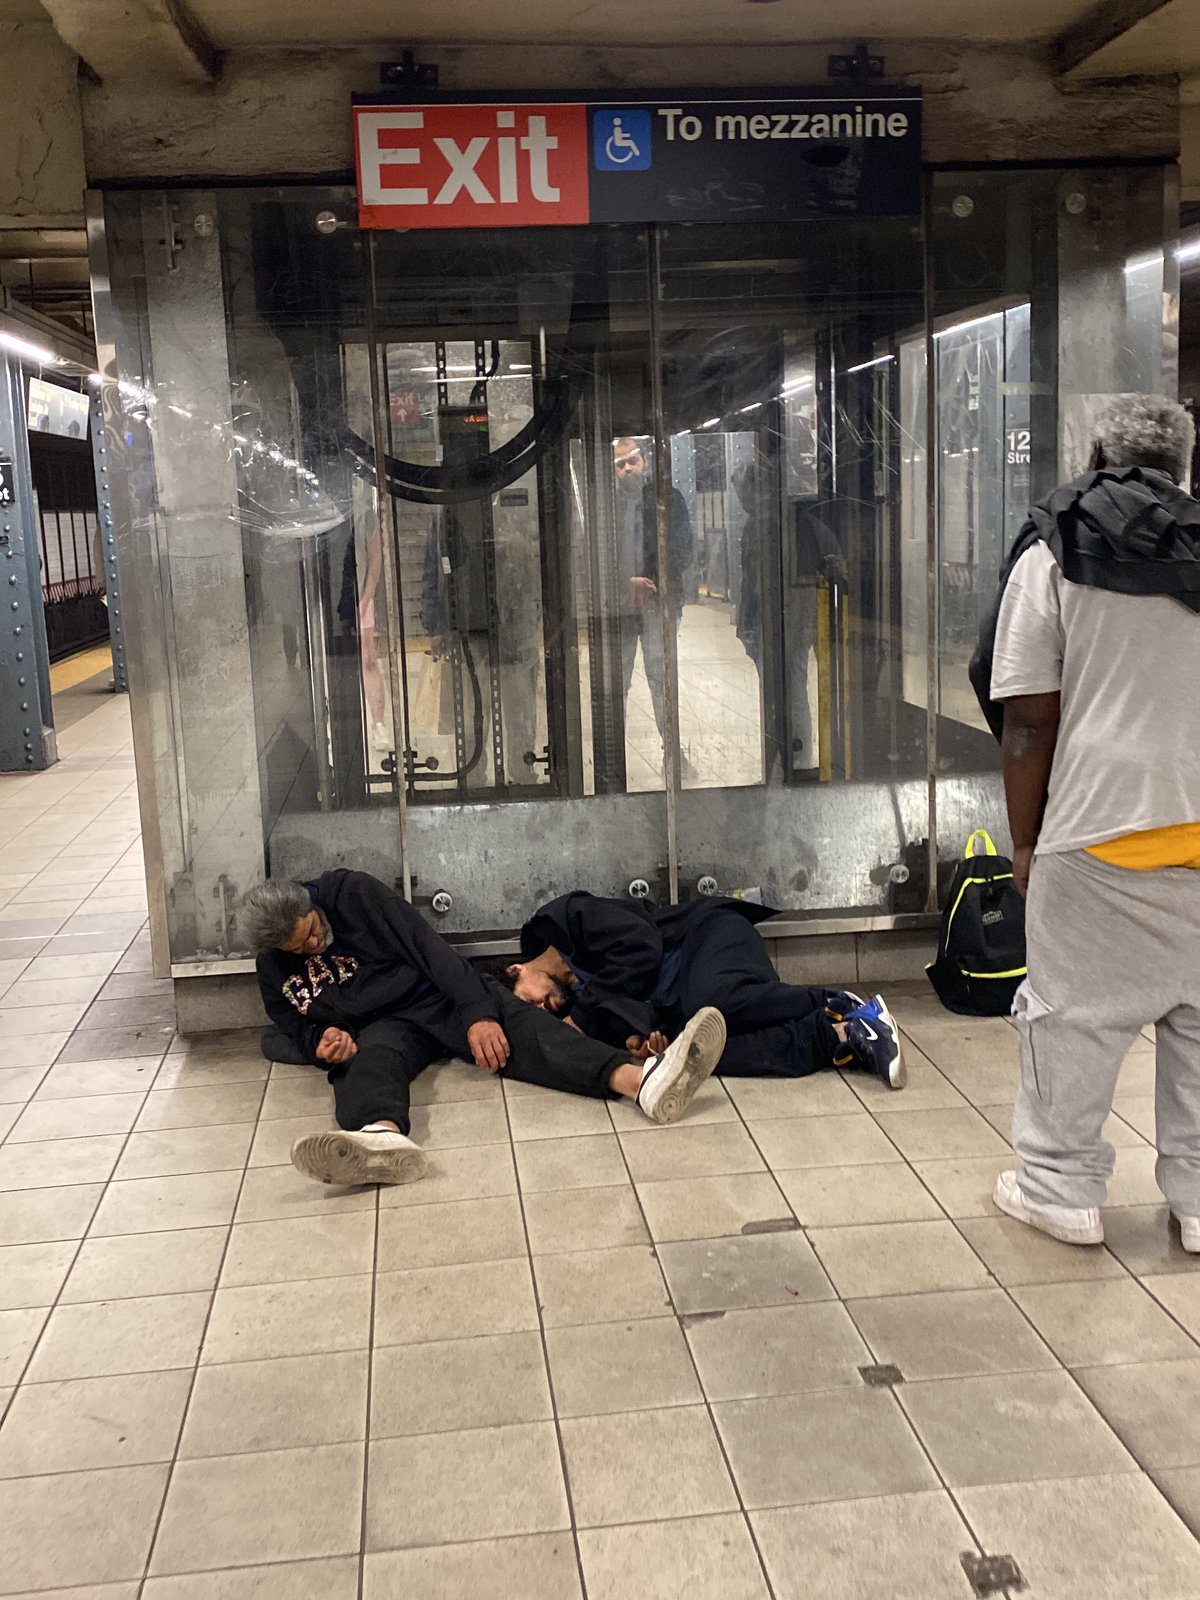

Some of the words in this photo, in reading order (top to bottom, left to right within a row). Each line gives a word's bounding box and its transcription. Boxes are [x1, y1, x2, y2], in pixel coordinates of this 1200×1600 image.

[657, 108, 702, 141] To
[715, 105, 909, 140] mezzanine
[357, 110, 561, 206] Exit
[389, 391, 415, 406] Exit
[281, 955, 359, 1015] GAP
